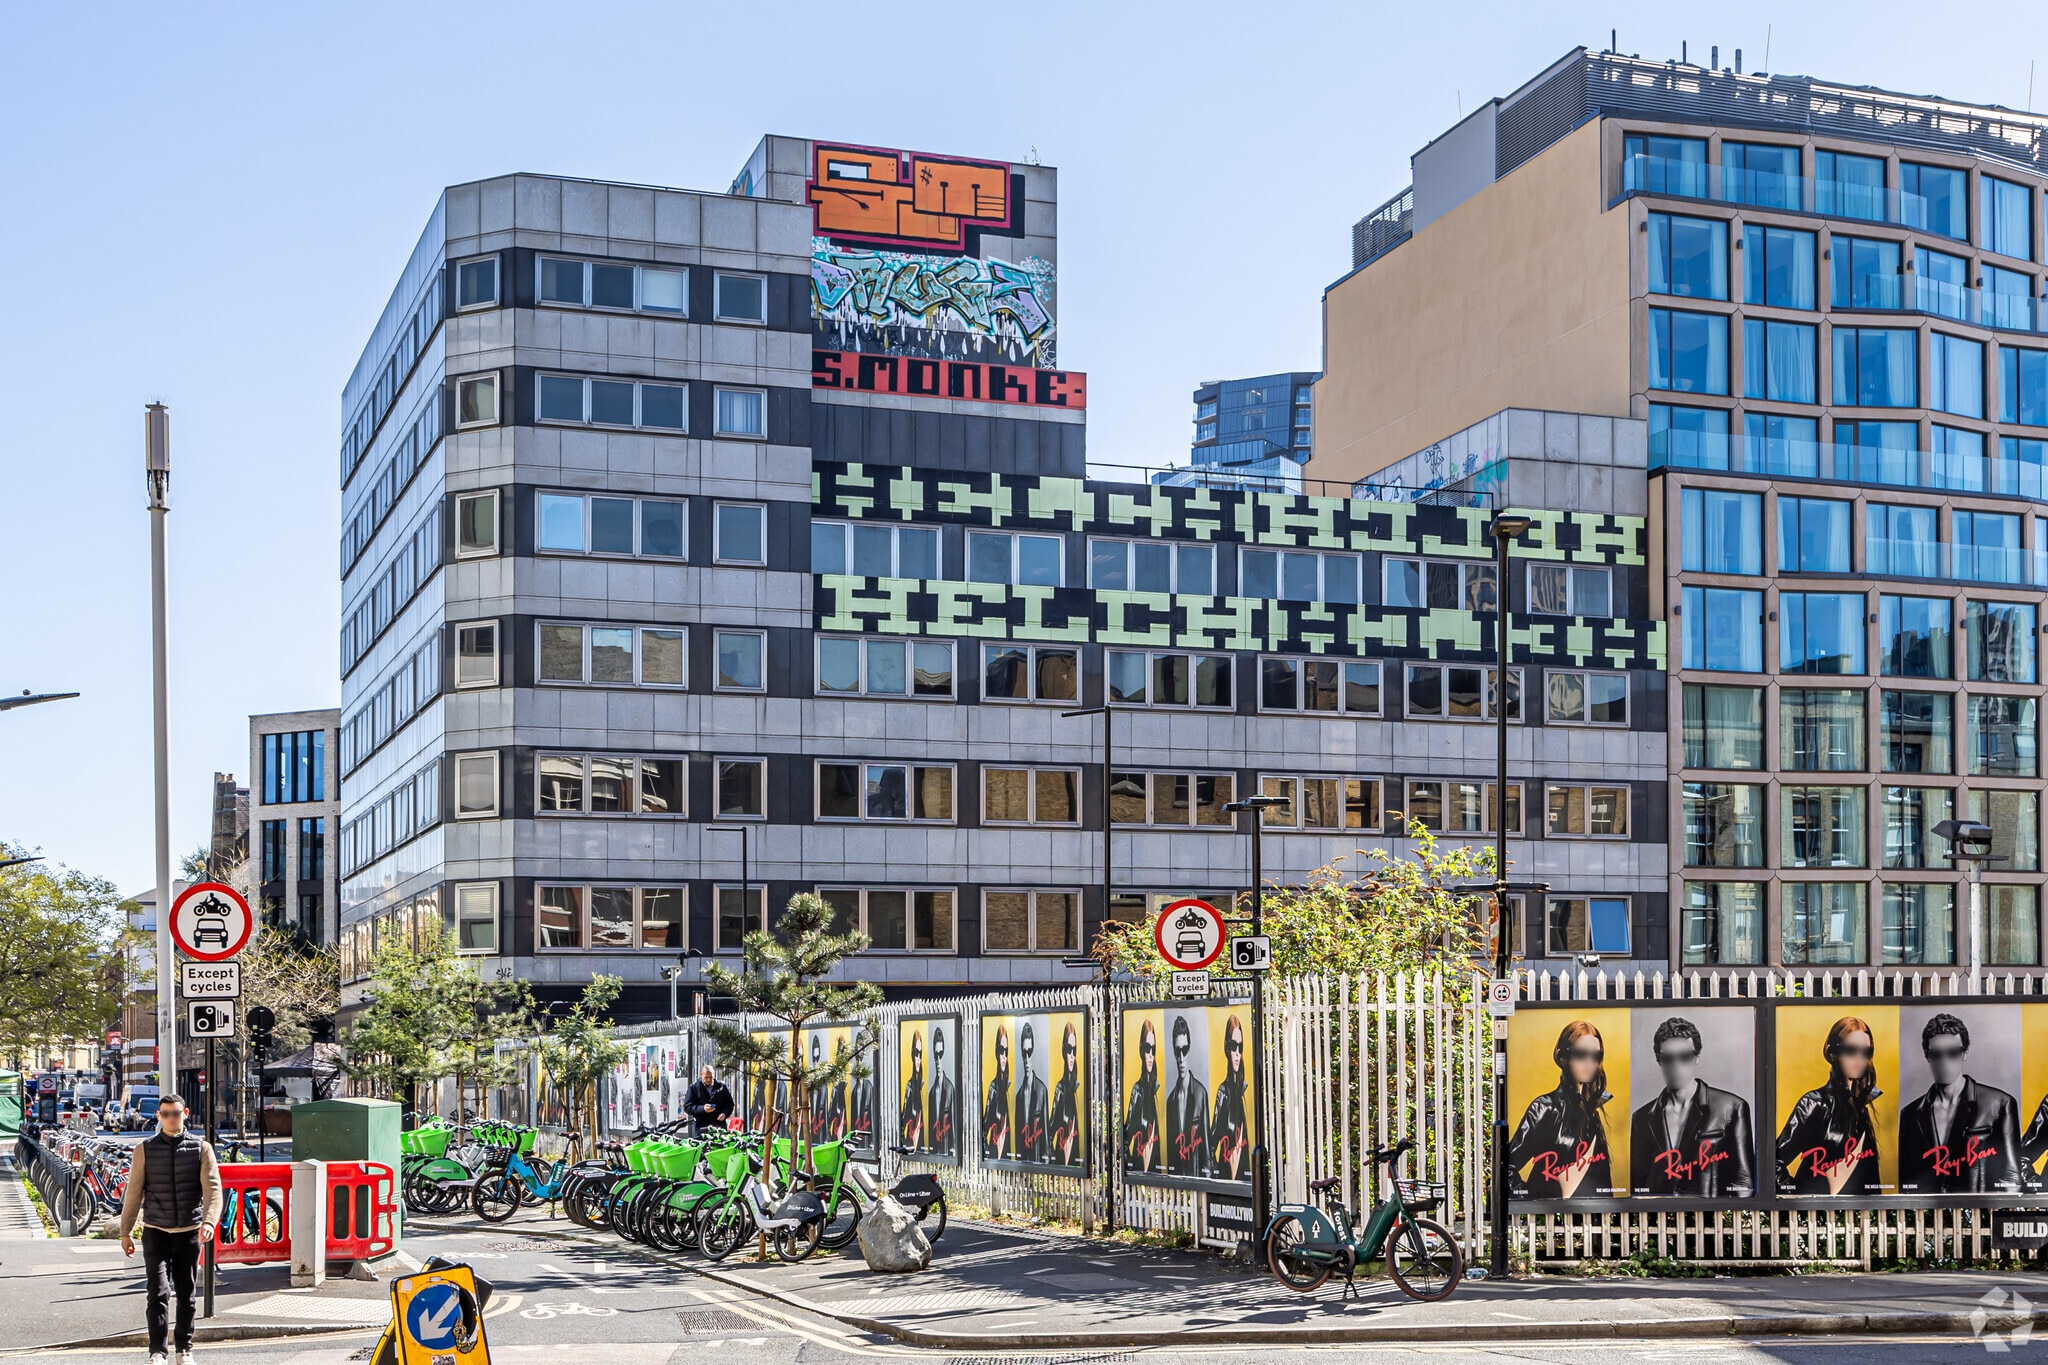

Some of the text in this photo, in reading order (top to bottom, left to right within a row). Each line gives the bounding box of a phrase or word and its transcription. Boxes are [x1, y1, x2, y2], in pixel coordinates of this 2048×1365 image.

[822, 574, 1262, 650] HELCH
[188, 968, 234, 980] Except
[1176, 974, 1206, 984] Except
[190, 981, 232, 994] cycles
[1177, 983, 1204, 992] cycles
[1333, 1210, 1348, 1242] forest
[2003, 1222, 2048, 1238] BUILD
